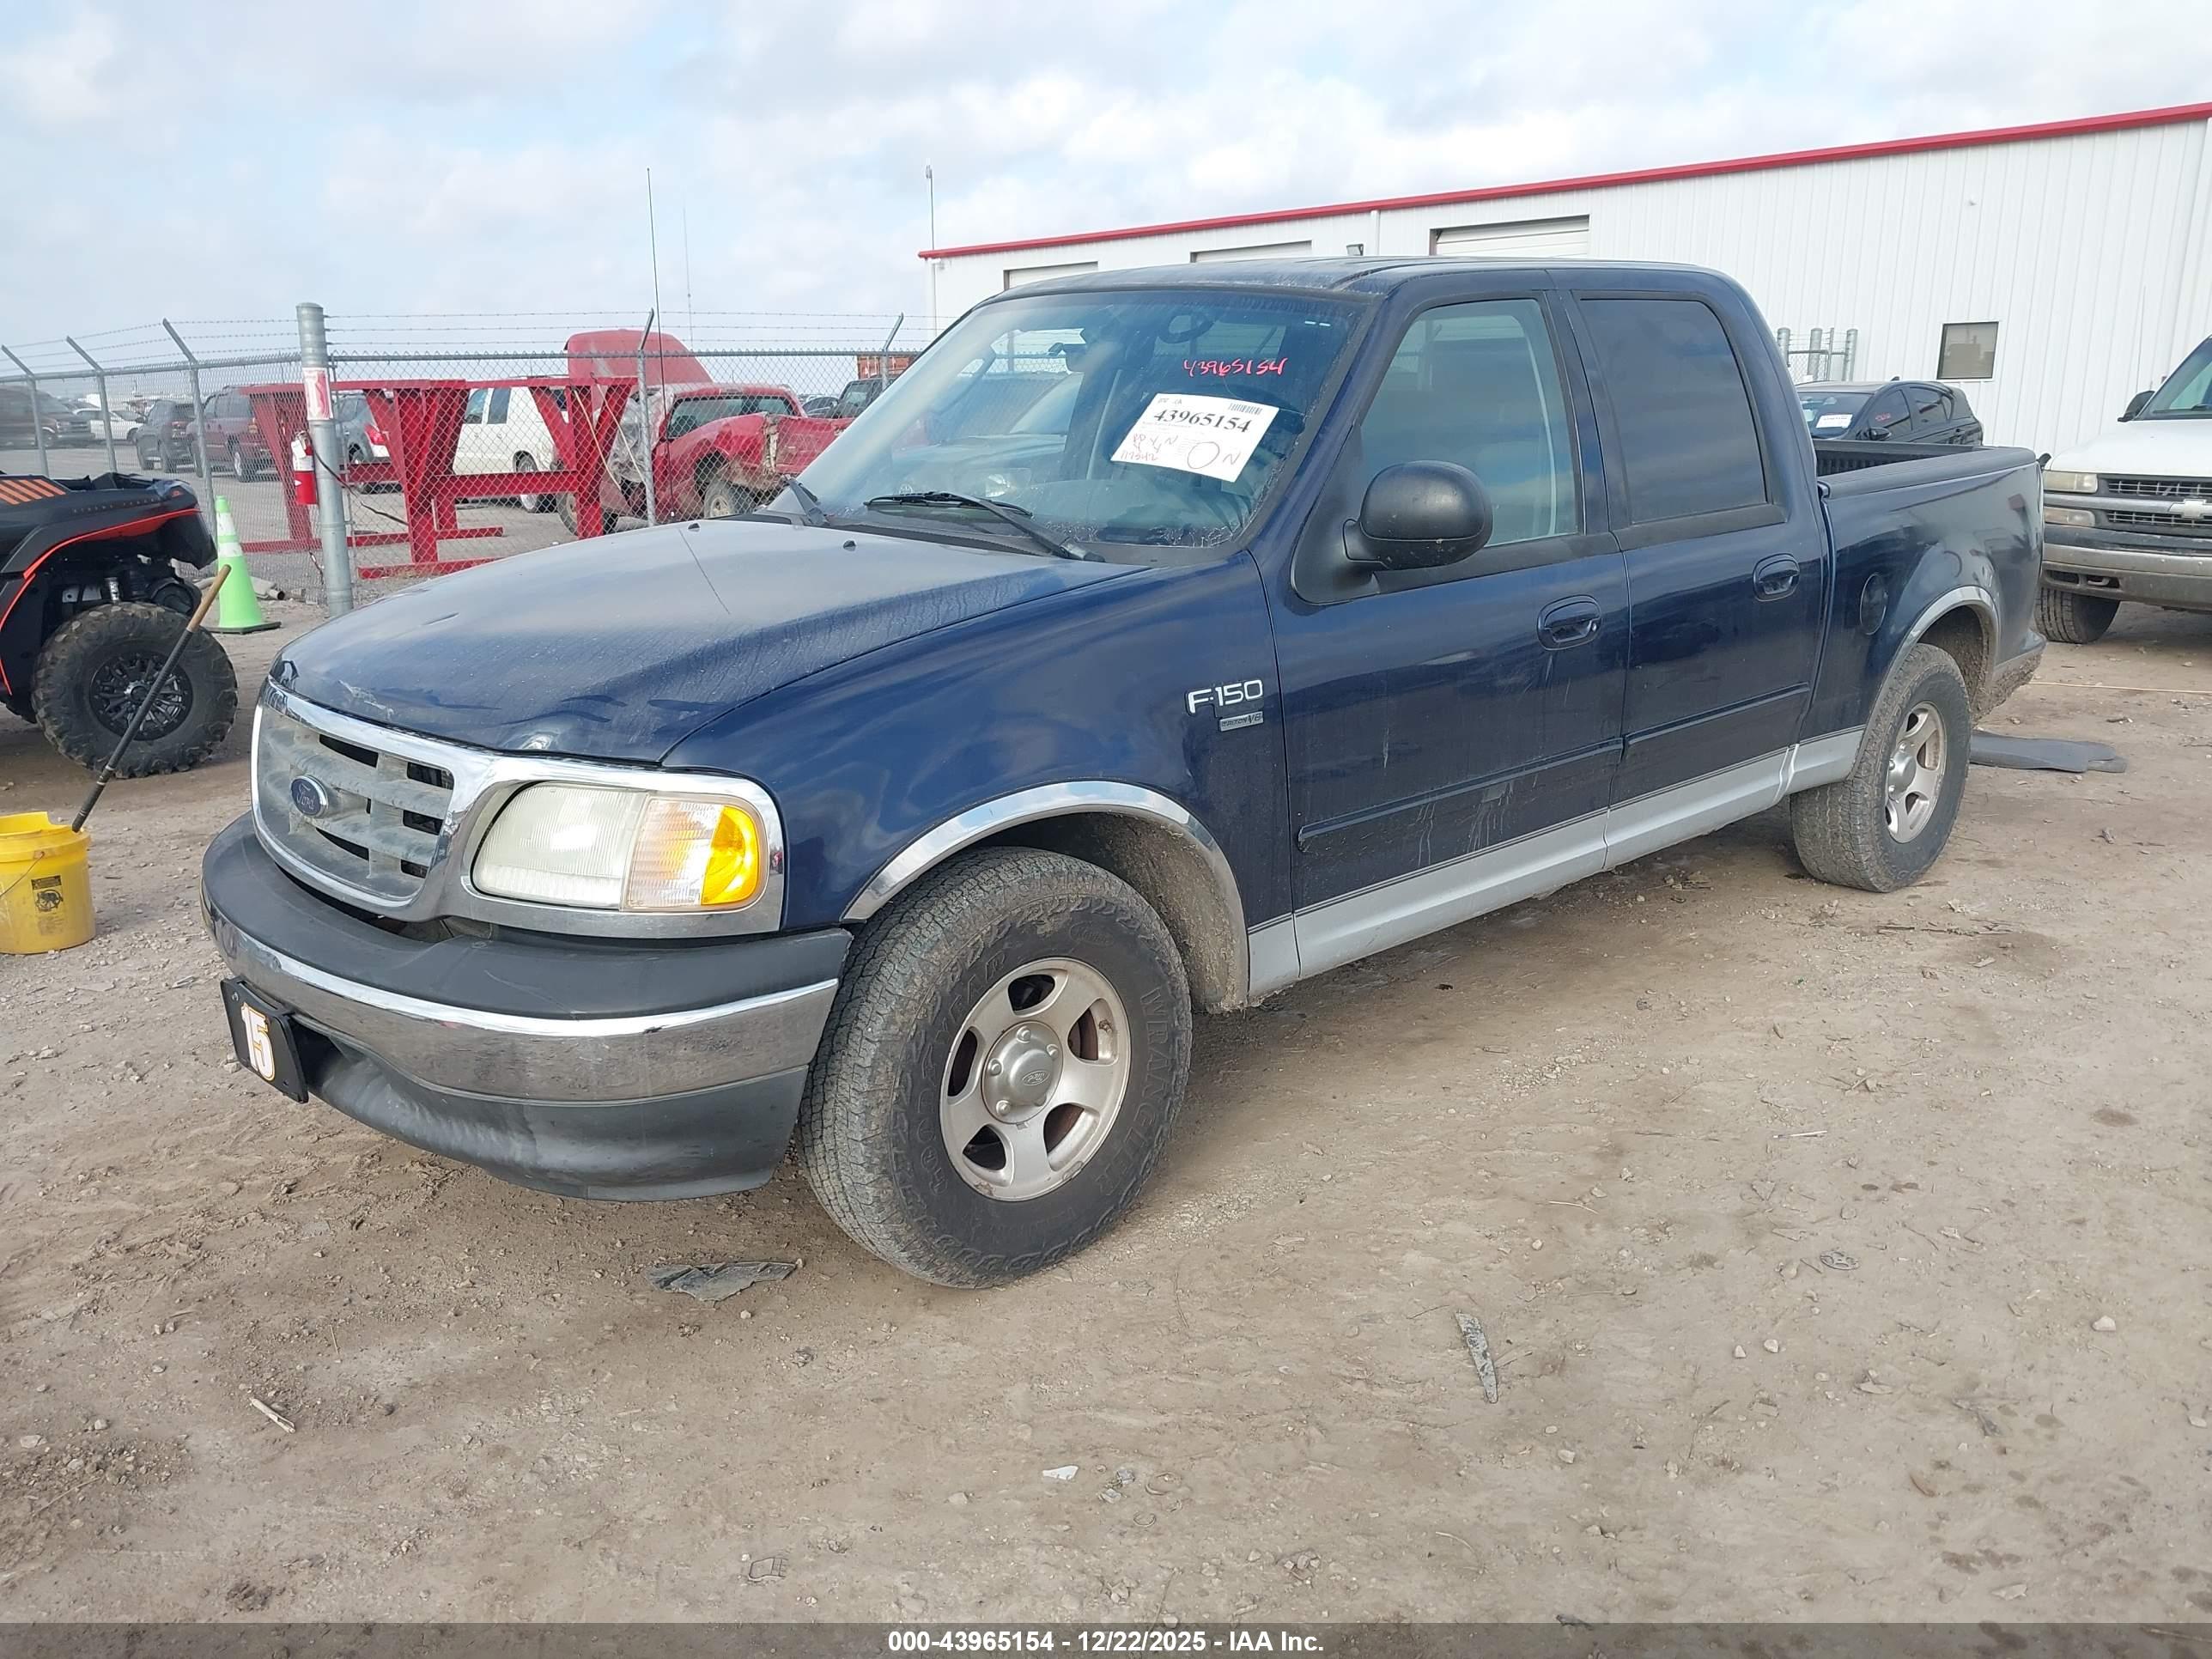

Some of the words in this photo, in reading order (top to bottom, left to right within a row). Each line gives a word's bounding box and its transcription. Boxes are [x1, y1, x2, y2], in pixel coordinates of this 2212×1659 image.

[1183, 357, 1289, 377] 43965154
[1153, 409, 1253, 433] 43965154
[295, 781, 318, 811] Ford
[240, 1001, 275, 1081] 15
